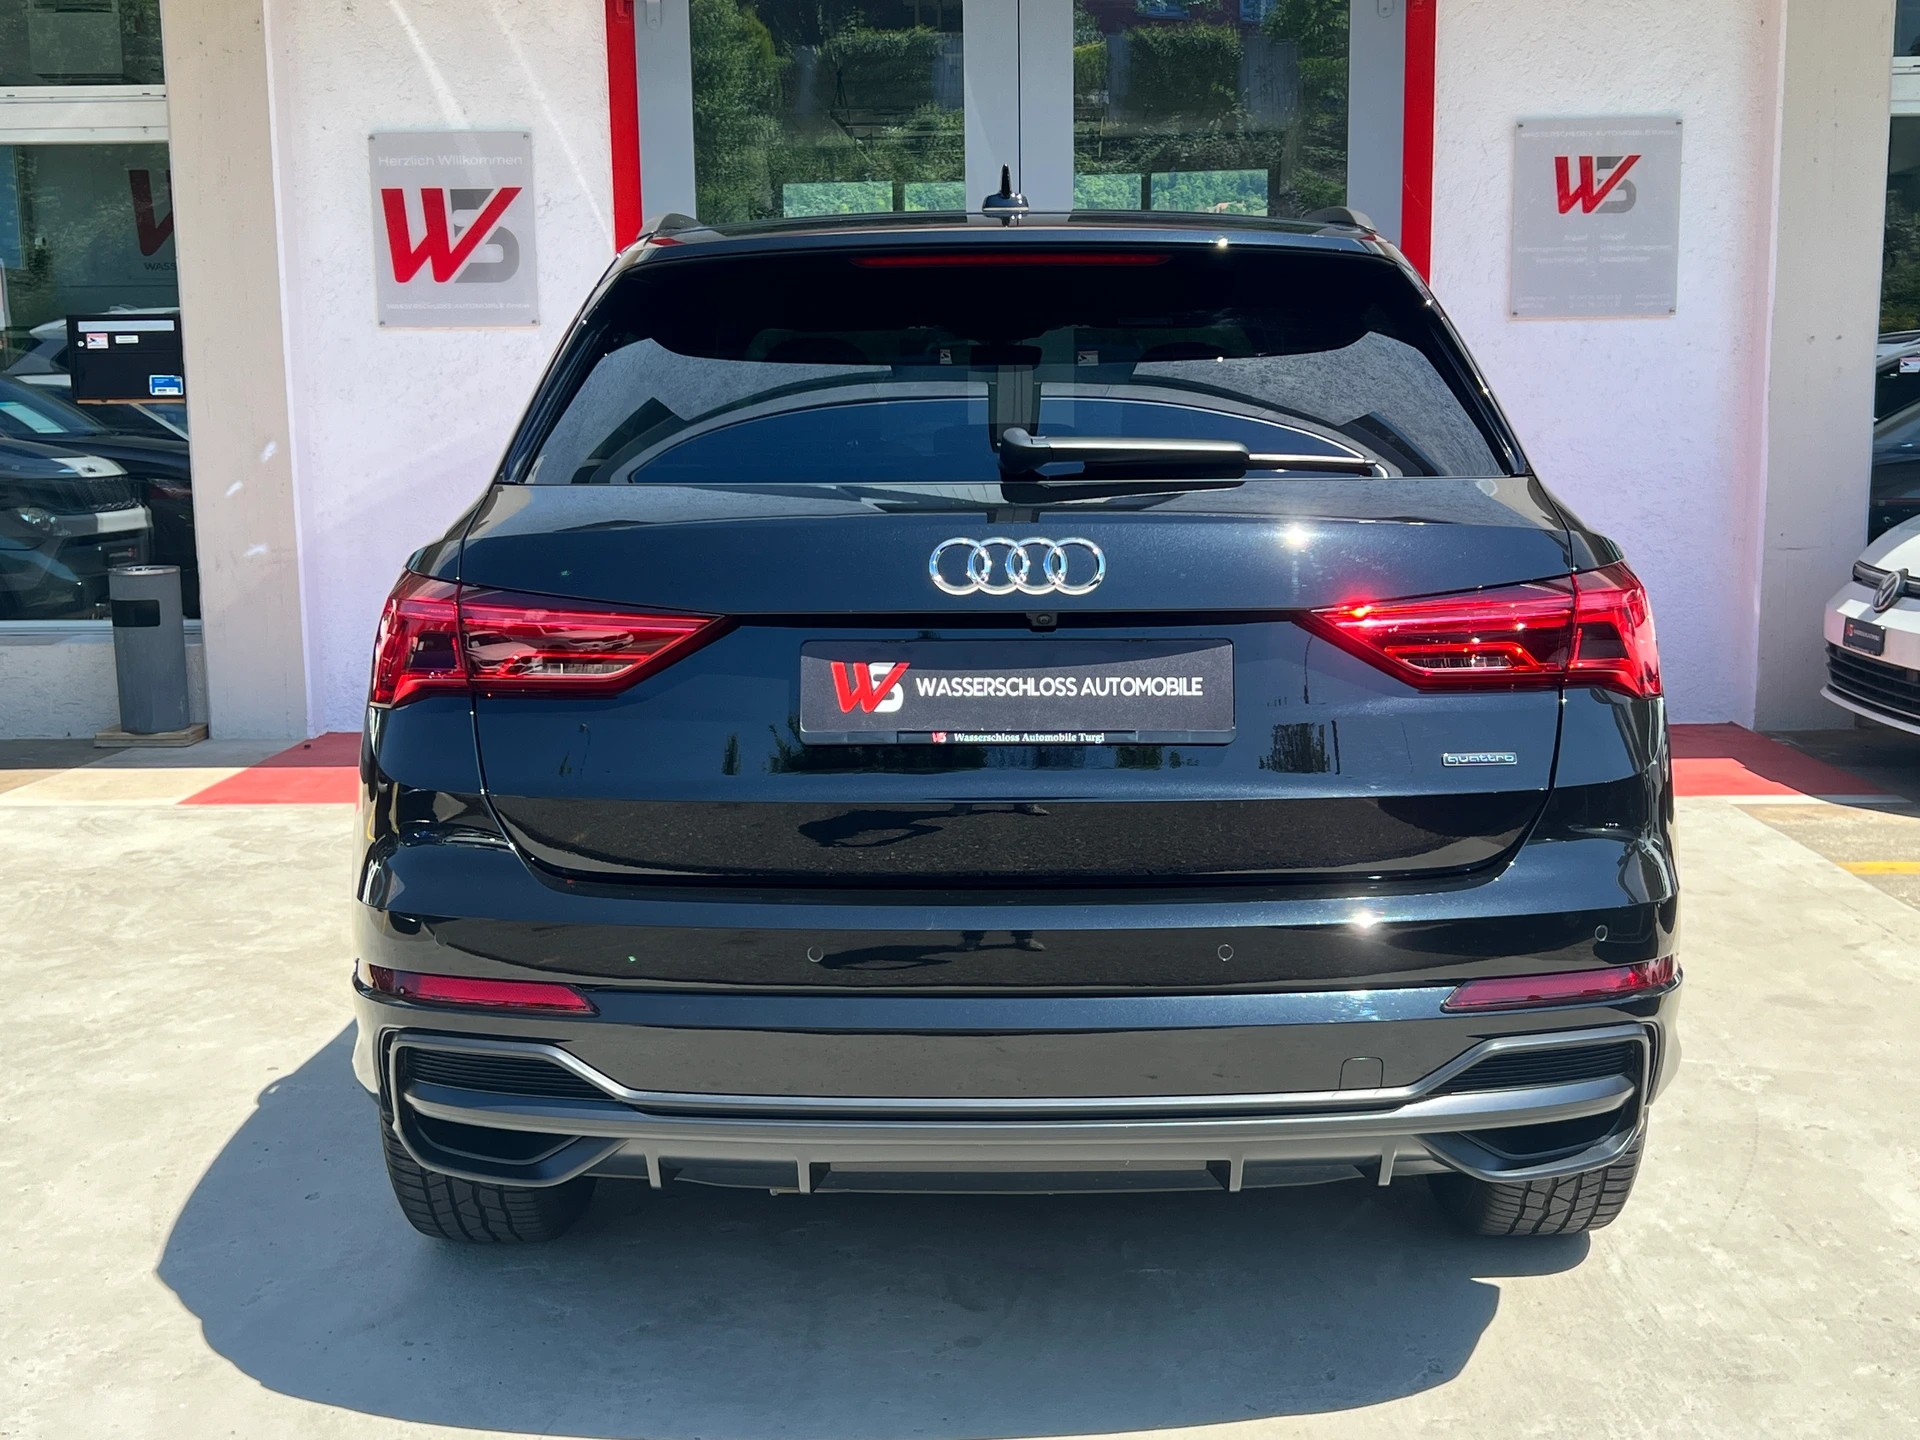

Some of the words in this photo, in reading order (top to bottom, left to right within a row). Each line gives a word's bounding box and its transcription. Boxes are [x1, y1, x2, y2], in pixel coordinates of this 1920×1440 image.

[378, 154, 435, 167] Herzlich
[437, 154, 523, 166] Willkommen
[915, 677, 1078, 697] WASSERSCHLOSS
[1080, 676, 1204, 697] AUTOMOBILE
[953, 732, 1020, 742] Wasserschloss
[1021, 732, 1077, 742] Automobile
[1078, 732, 1106, 744] Turgi
[1447, 754, 1515, 765] quattro
